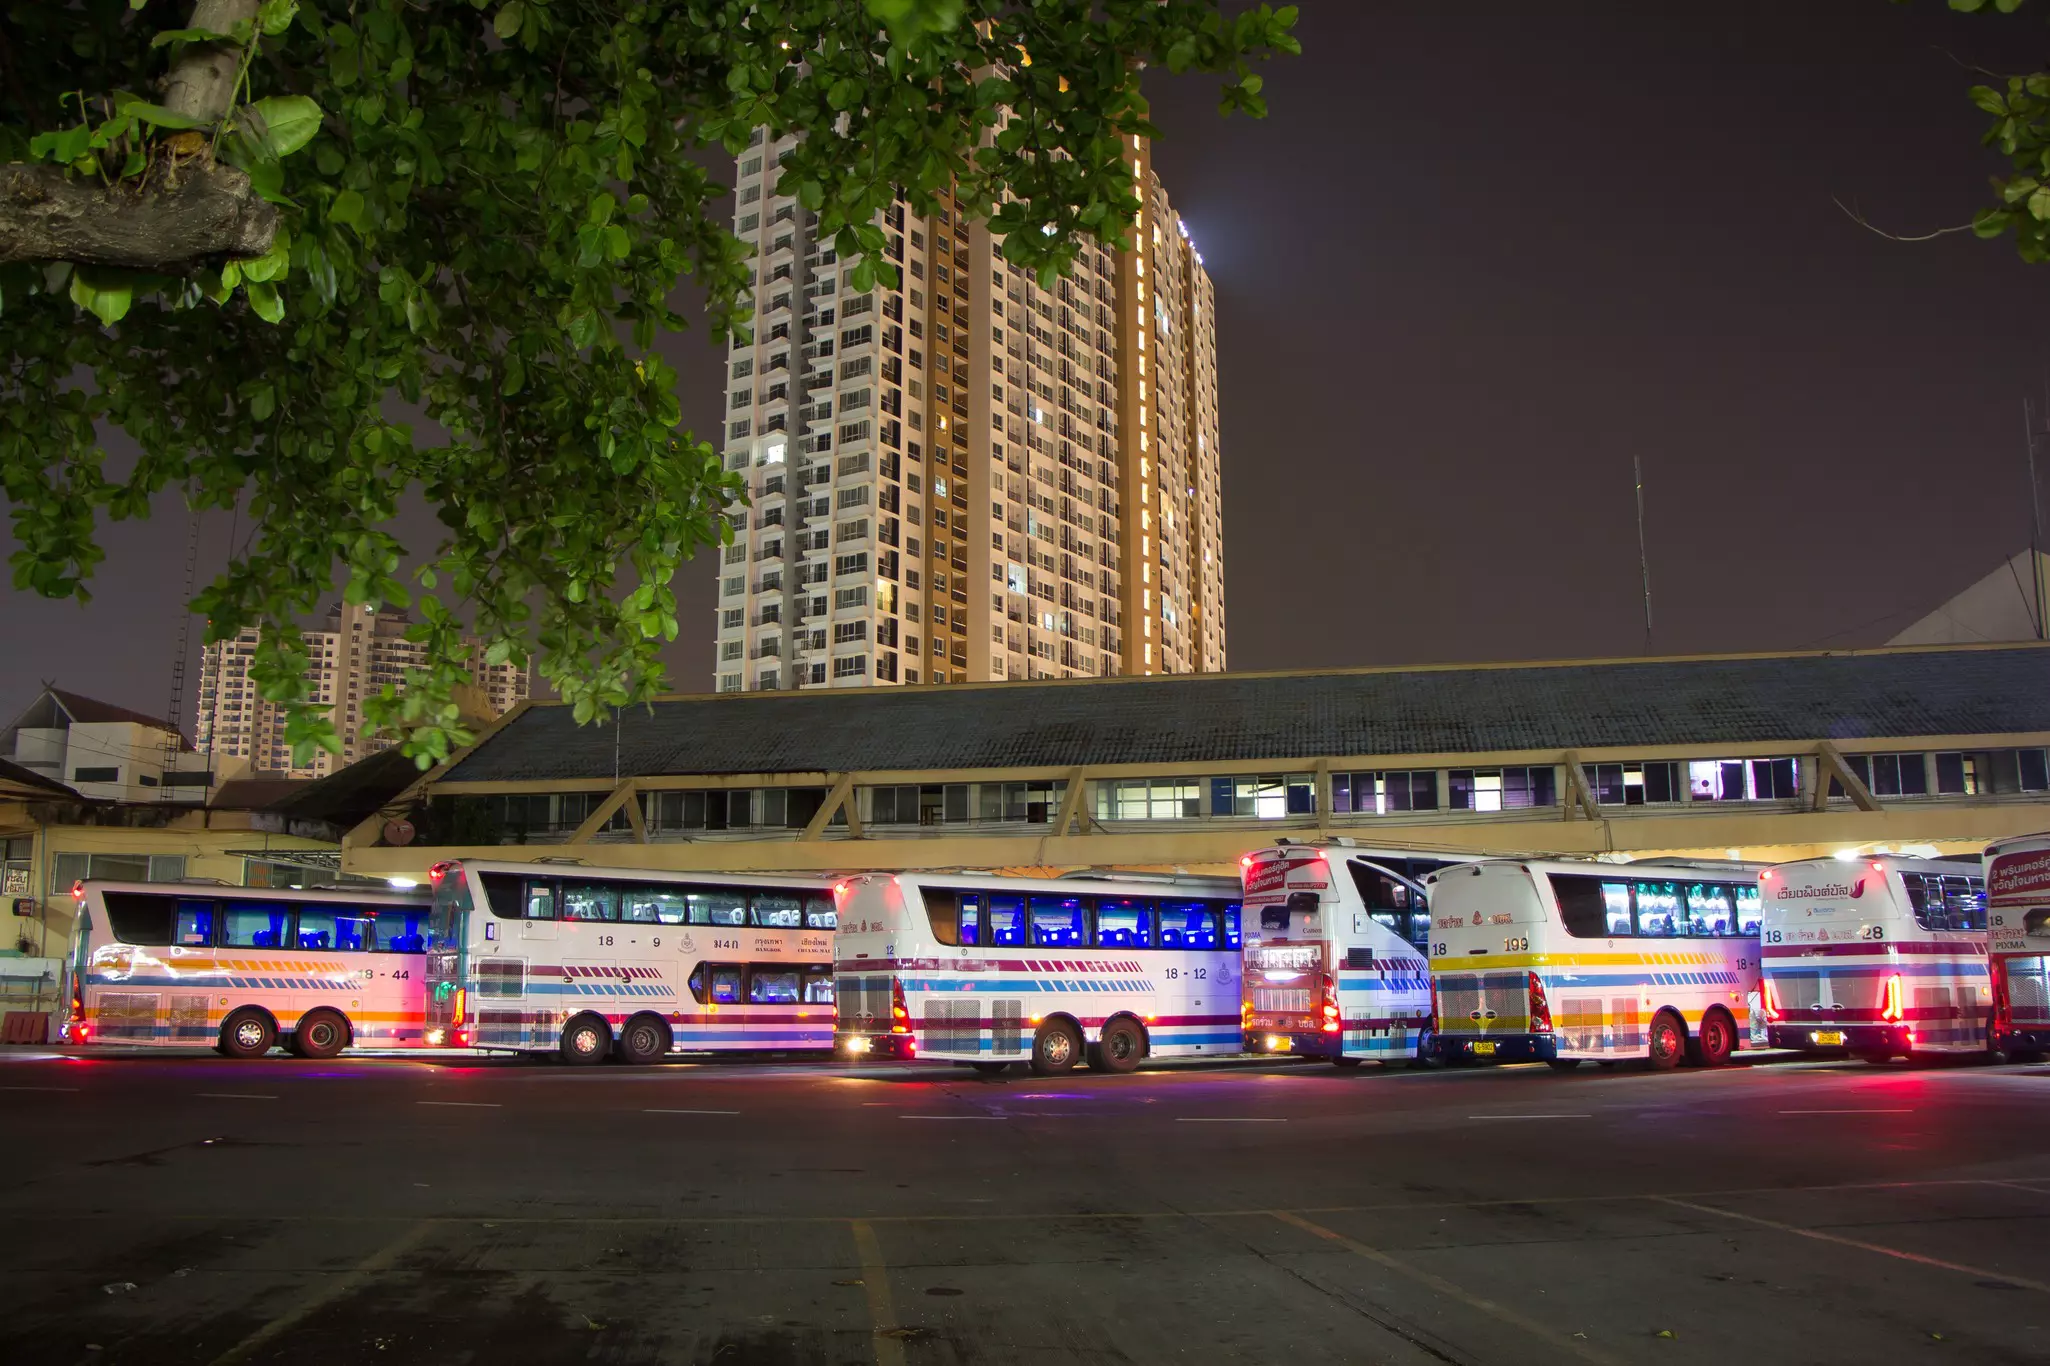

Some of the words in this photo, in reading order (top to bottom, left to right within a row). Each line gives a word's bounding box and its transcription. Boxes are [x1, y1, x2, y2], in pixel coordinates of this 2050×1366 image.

[1990, 915, 2004, 926] 18
[598, 935, 614, 946] 18
[653, 937, 660, 947] 9
[1765, 930, 1782, 943] 18
[886, 944, 894, 955] 12
[1432, 943, 1447, 956] 18
[1503, 937, 1529, 952] 199
[1995, 940, 2026, 949] PIXMA
[1735, 958, 1747, 970] 18
[392, 970, 409, 980] 44
[1165, 967, 1178, 979] 18
[1193, 968, 1207, 980] 12
